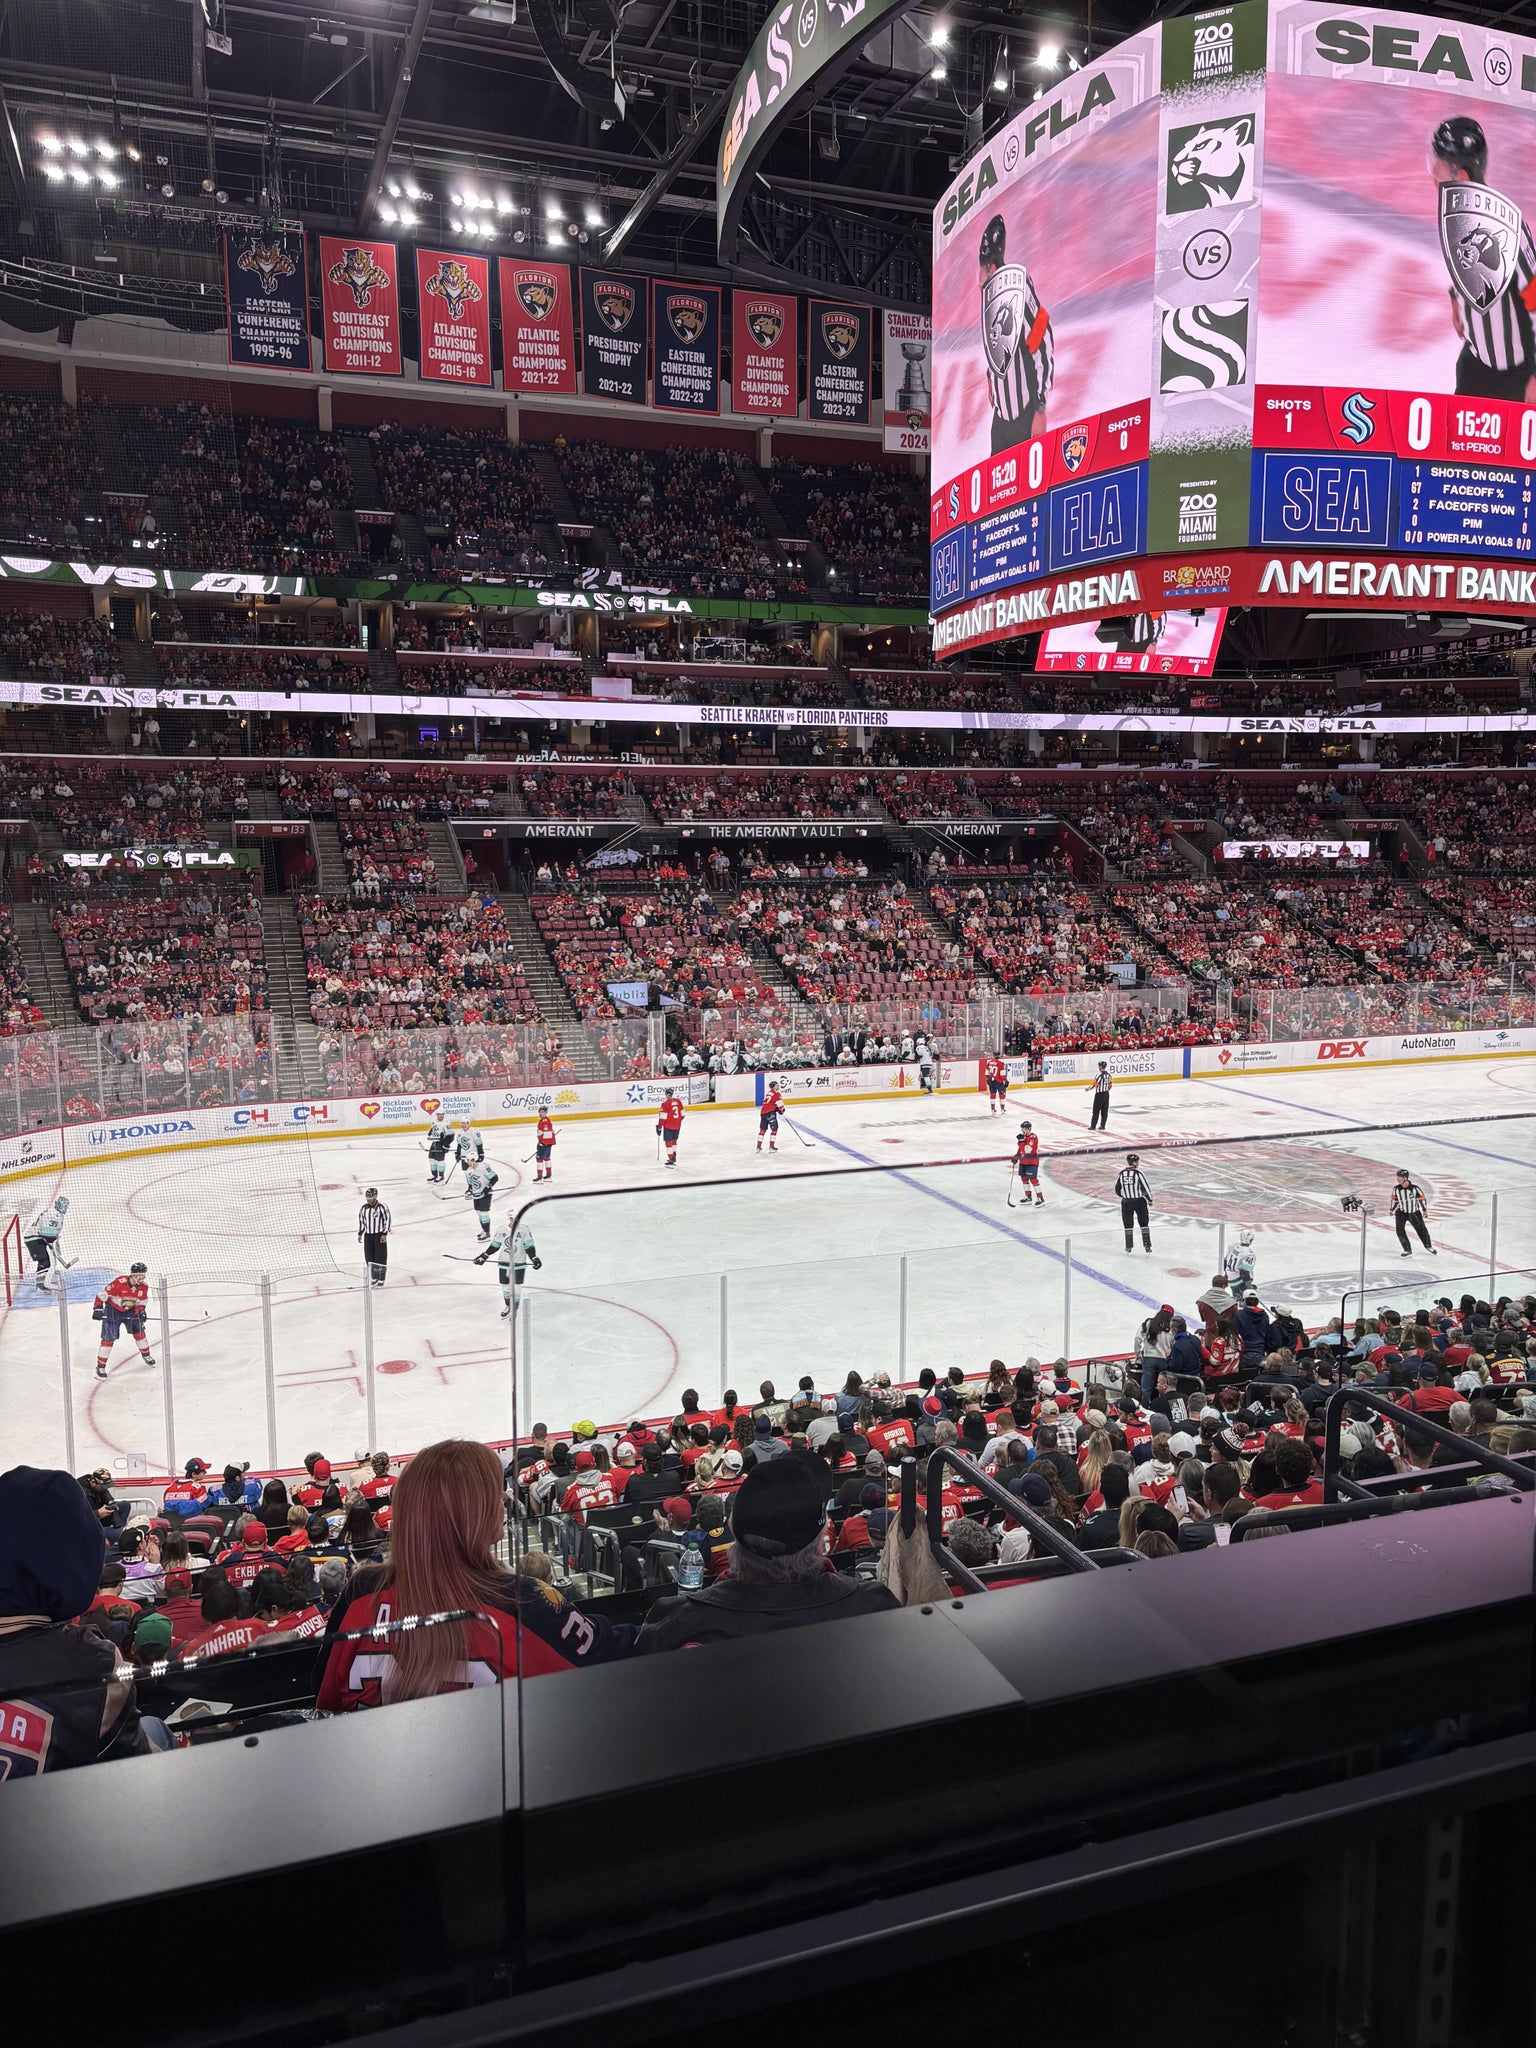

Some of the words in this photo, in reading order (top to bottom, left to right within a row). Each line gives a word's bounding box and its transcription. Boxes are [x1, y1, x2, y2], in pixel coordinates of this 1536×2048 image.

[1194, 8, 1225, 21] PRESENTED
[1225, 7, 1234, 15] BY
[1194, 22, 1234, 46] ZOO
[1193, 46, 1233, 71] MIAMI
[1315, 20, 1474, 82] SEA
[1193, 64, 1233, 80] FOUNDATION
[1025, 71, 1116, 157] FLA
[722, 69, 762, 188] SEA
[1004, 141, 1017, 160] VS
[942, 155, 998, 237] SEA
[1453, 191, 1516, 223] FLORIDA
[1193, 245, 1222, 266] VS
[245, 298, 292, 315] EASTERN
[237, 313, 301, 332] CONFERENCE
[332, 311, 390, 328] SOUTHEAST
[887, 313, 921, 328] STANLEY
[239, 327, 300, 346] CHAMPIONS
[340, 326, 385, 340] DIVISION
[433, 322, 478, 339] ATLANTIC
[517, 328, 560, 342] ATLANTIC
[889, 326, 932, 341] CHAMPION
[333, 338, 392, 354] CHAMPIONS
[434, 335, 476, 351] DIVISION
[518, 342, 560, 356] DIVISION
[588, 334, 642, 355] PRESIDENTS'
[249, 343, 292, 360] 1995-96
[428, 348, 484, 366] CHAMPIONS
[599, 350, 632, 367] TROPHY
[668, 349, 706, 365] EASTERN
[346, 353, 381, 367] 2011-12
[512, 355, 567, 371] CHAMPIONS
[746, 355, 785, 370] ATLANTIC
[440, 363, 477, 379] 2015-16
[521, 371, 560, 385] 2021-22
[660, 361, 713, 379] CONFERENCE
[746, 367, 783, 382] DIVISION
[822, 364, 857, 379] EASTERN
[598, 378, 633, 396] 2021-22
[662, 375, 711, 392] CHAMPIONS
[740, 380, 790, 397] CHAMPIONS
[815, 376, 865, 392] CONFERENCE
[669, 389, 704, 404] 2022-23
[748, 394, 783, 408] 2023-24
[816, 389, 863, 405] CHAMPIONS
[822, 403, 856, 418] 2023-24
[1266, 399, 1312, 411] SHOTS
[1108, 415, 1142, 434] SHOTS
[1285, 412, 1293, 433] 1
[1408, 397, 1432, 451] 0
[1456, 410, 1501, 439] 15:20
[900, 433, 929, 449] 2024
[1120, 430, 1129, 450] 0
[1451, 441, 1465, 451] 1st
[1466, 441, 1502, 454] PERIOD
[1028, 441, 1043, 490] 0
[991, 459, 1017, 490] 15:20
[1431, 467, 1470, 479] SHOTS
[1471, 470, 1487, 481] ON
[1488, 472, 1517, 484] GOAL
[971, 469, 981, 514] 0
[1180, 480, 1206, 489] PRESENTED
[1411, 482, 1422, 494] 67
[1443, 484, 1495, 498] FACEOFF
[1496, 488, 1504, 499] %
[1522, 491, 1531, 503] 33
[997, 485, 1018, 501] PERIOD
[1282, 466, 1371, 533] SEA
[1180, 493, 1217, 511] ZOO
[1429, 500, 1489, 513] FACEOFFS
[1491, 504, 1515, 516] WON
[979, 516, 1000, 532] SHOTS
[1009, 506, 1028, 520] GOAL
[1062, 484, 1123, 557] FLA
[1179, 516, 1217, 535] MIAMI
[1463, 518, 1482, 529] PIM
[985, 526, 1013, 543] FACEOFF
[1178, 533, 1217, 543] FOUNDATION
[1405, 531, 1423, 544] 0/0
[1427, 532, 1460, 544] POWER
[1460, 534, 1484, 545] PLAY
[1485, 536, 1513, 547] GOALS
[1516, 538, 1531, 551] 0/0
[979, 541, 1011, 559] FACEOFFS
[1011, 535, 1028, 547] WON
[68, 562, 158, 588] VS
[935, 540, 960, 601] SEA
[1008, 564, 1027, 577] GOALS
[1196, 577, 1229, 588] COUNTY
[1258, 560, 1455, 598] AMERANT
[1458, 566, 1536, 604] BANK
[536, 592, 590, 607] SEA
[1163, 586, 1230, 597] FLORIDA
[648, 598, 693, 613] FLA
[932, 602, 996, 652] AMERANT
[996, 588, 1050, 628] BANK
[1051, 570, 1140, 617] ARENA
[40, 687, 107, 703] SEA
[183, 693, 237, 706] FLA
[701, 707, 743, 722] SEATTLE
[745, 708, 785, 723] KRAKEN
[786, 712, 795, 722] VS
[796, 710, 837, 724] FLORIDA
[838, 711, 888, 725] PANTHERS
[1240, 719, 1285, 730] SEA
[1337, 720, 1376, 730] FLA
[239, 825, 255, 834] 132
[291, 825, 306, 834] 133
[525, 825, 594, 837] AMERANT
[709, 826, 731, 837] THE
[735, 825, 797, 837] AMERANT
[801, 826, 844, 837] VAULT
[945, 824, 1002, 836] AMERANT
[185, 853, 236, 865] FLA
[1317, 1040, 1369, 1060] DEX
[1401, 1036, 1456, 1050] AutoNation
[1053, 1059, 1076, 1068] TROPICAL
[1109, 1052, 1156, 1064] COMCAST
[1053, 1066, 1077, 1075] FINANCIAL
[1110, 1062, 1156, 1074] BUSINESS
[382, 1099, 413, 1107] Nicklaus
[442, 1095, 472, 1103] Nicklaus
[502, 1093, 552, 1109] Surfside
[233, 1109, 269, 1125] CH
[294, 1104, 328, 1121] CH
[671, 1106, 679, 1119] 3
[224, 1124, 248, 1132] Cooper
[284, 1119, 307, 1127] Cooper
[316, 1117, 339, 1125] Hunter
[109, 1120, 195, 1141] HONDA
[1123, 1177, 1134, 1185] 56
[1228, 1257, 1238, 1272] 41
[576, 1481, 612, 1499] MARCHAND
[560, 1610, 594, 1655] 3
[199, 1627, 253, 1658] EINHART
